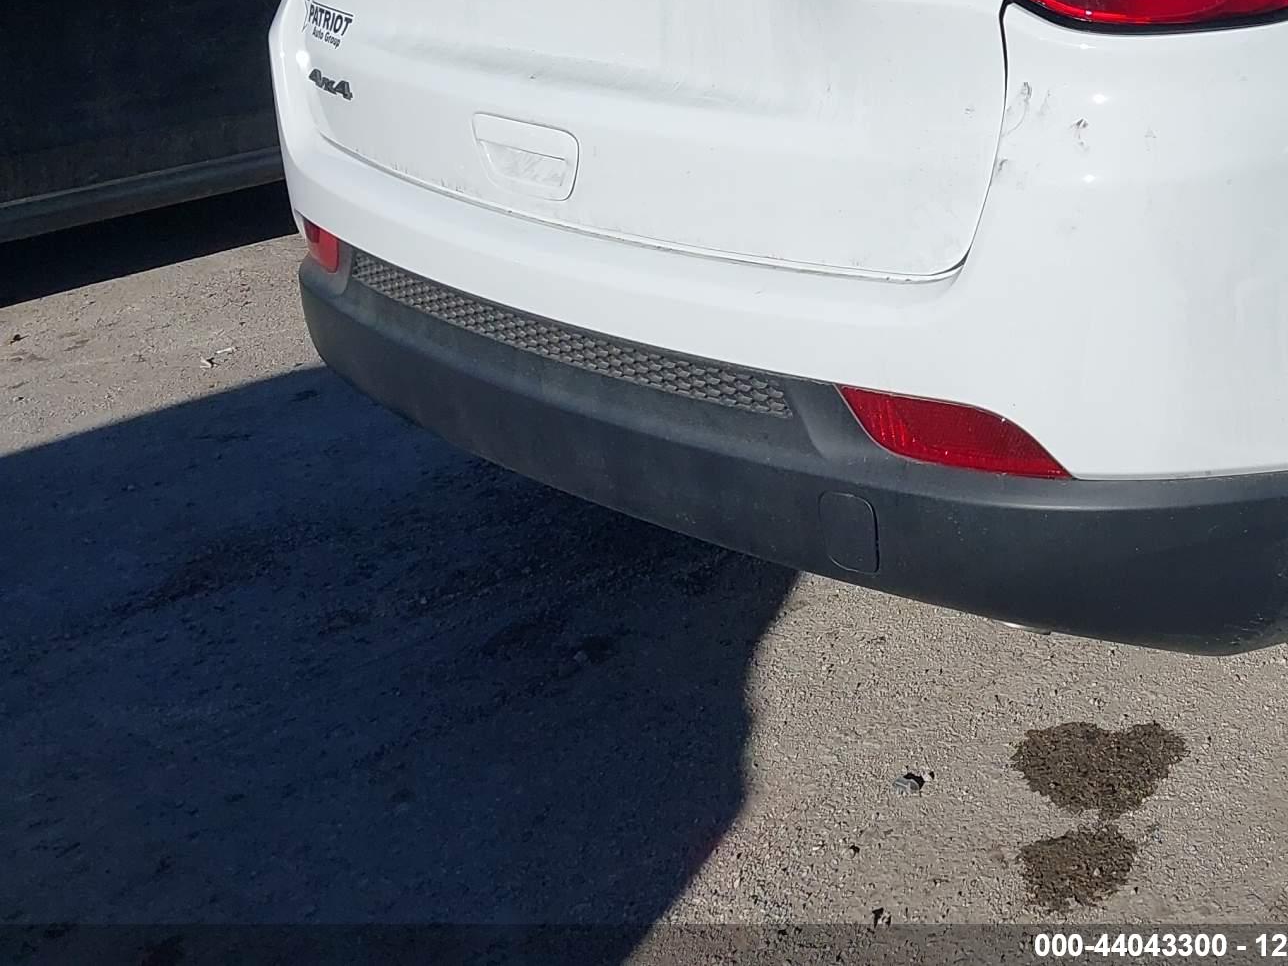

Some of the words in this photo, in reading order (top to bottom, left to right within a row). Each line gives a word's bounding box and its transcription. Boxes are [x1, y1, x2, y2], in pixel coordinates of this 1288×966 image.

[309, 3, 353, 37] PATRIOT
[311, 27, 324, 40] Auto
[325, 33, 341, 49] Group
